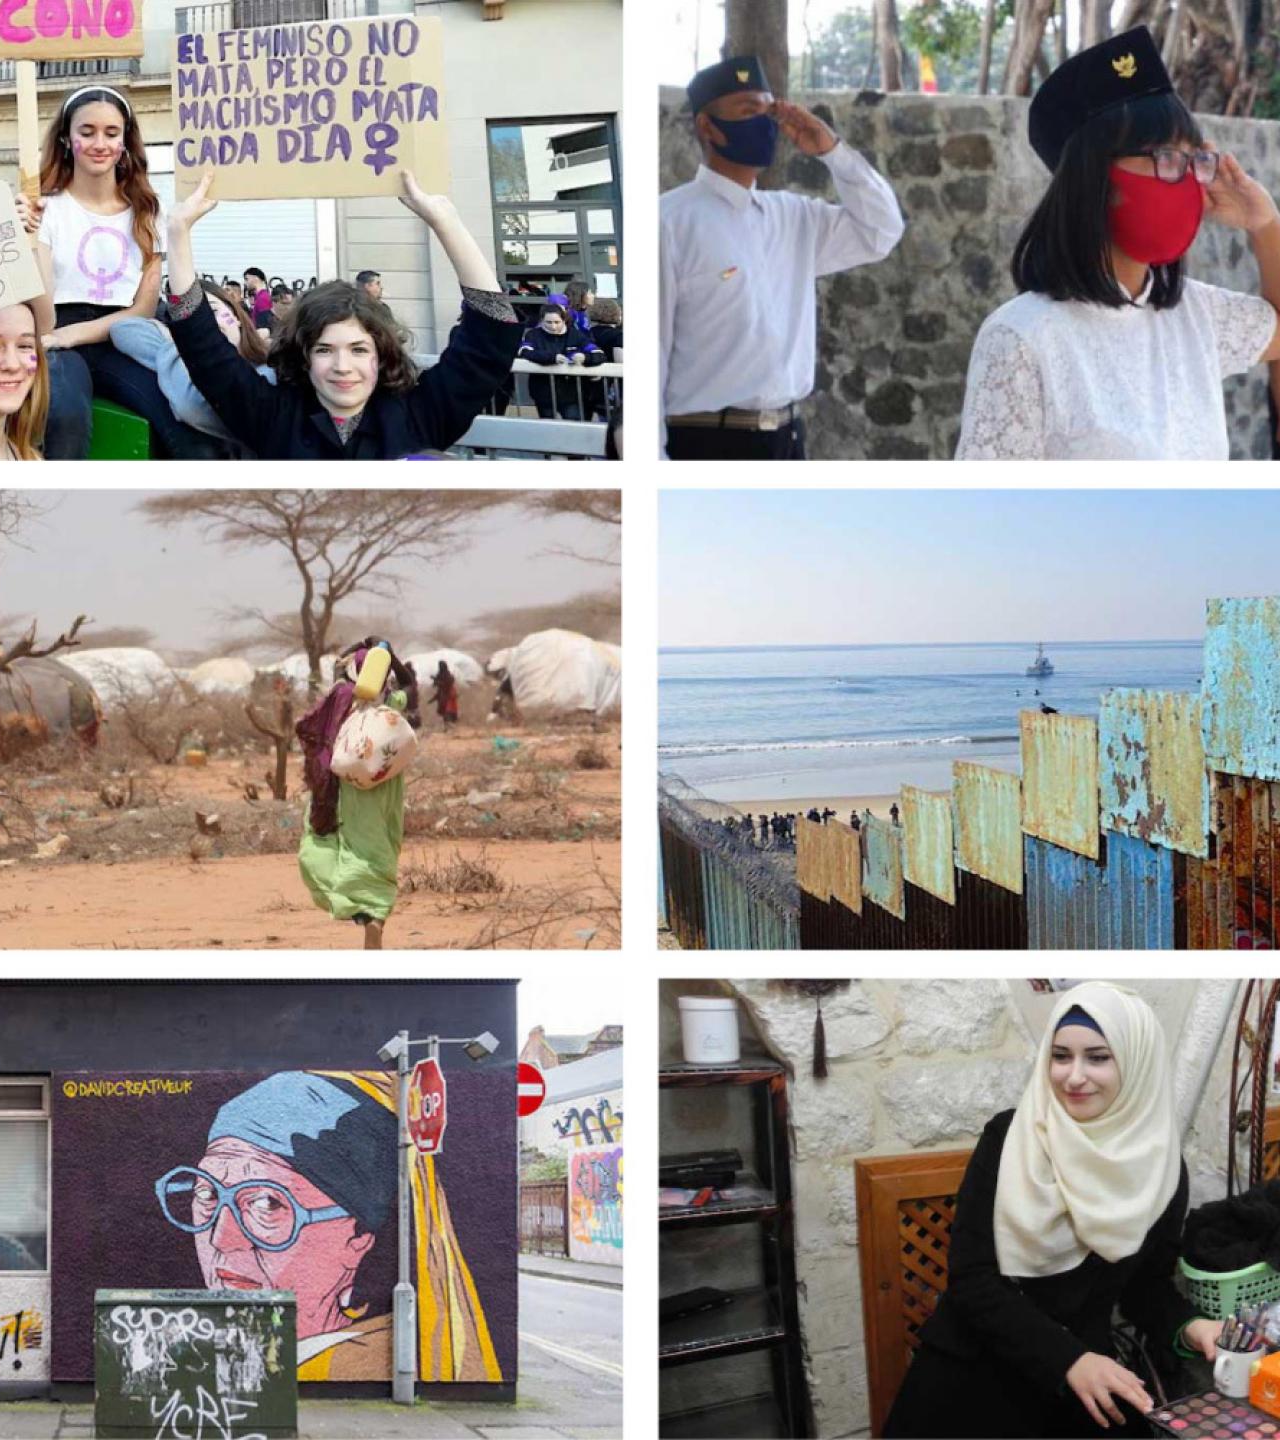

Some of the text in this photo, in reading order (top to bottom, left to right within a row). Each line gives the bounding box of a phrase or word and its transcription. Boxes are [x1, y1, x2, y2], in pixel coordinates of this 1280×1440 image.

[177, 19, 420, 64] EL FEMINISO NO
[177, 55, 387, 98] MATA, PERO EL
[352, 82, 438, 122] MATA
[177, 131, 258, 167] CADA
